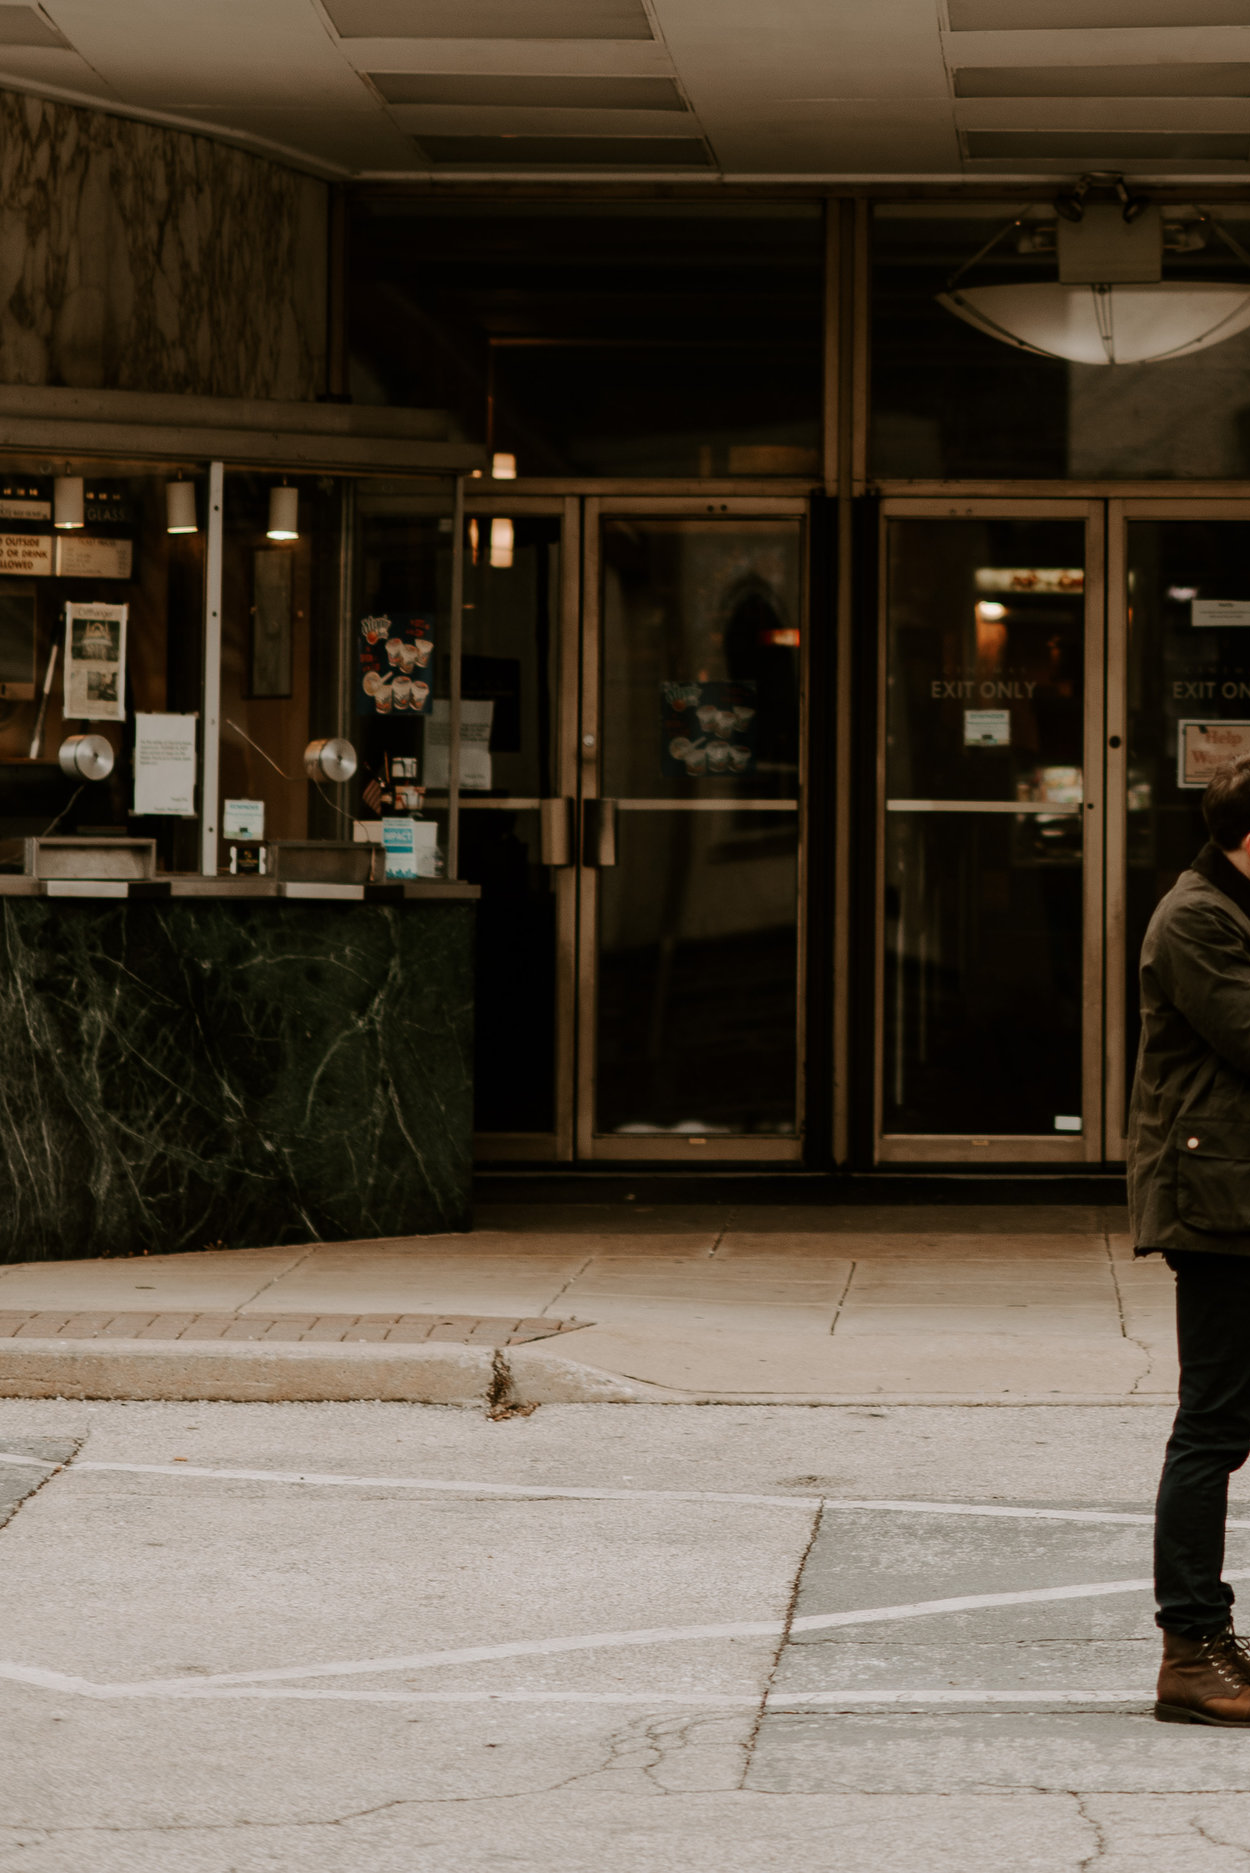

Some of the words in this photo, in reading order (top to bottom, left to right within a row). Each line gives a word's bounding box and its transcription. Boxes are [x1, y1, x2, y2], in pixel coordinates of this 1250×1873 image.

[930, 681, 975, 699] EXIT
[979, 681, 1037, 699] ONLY
[1172, 681, 1217, 699] EXIT
